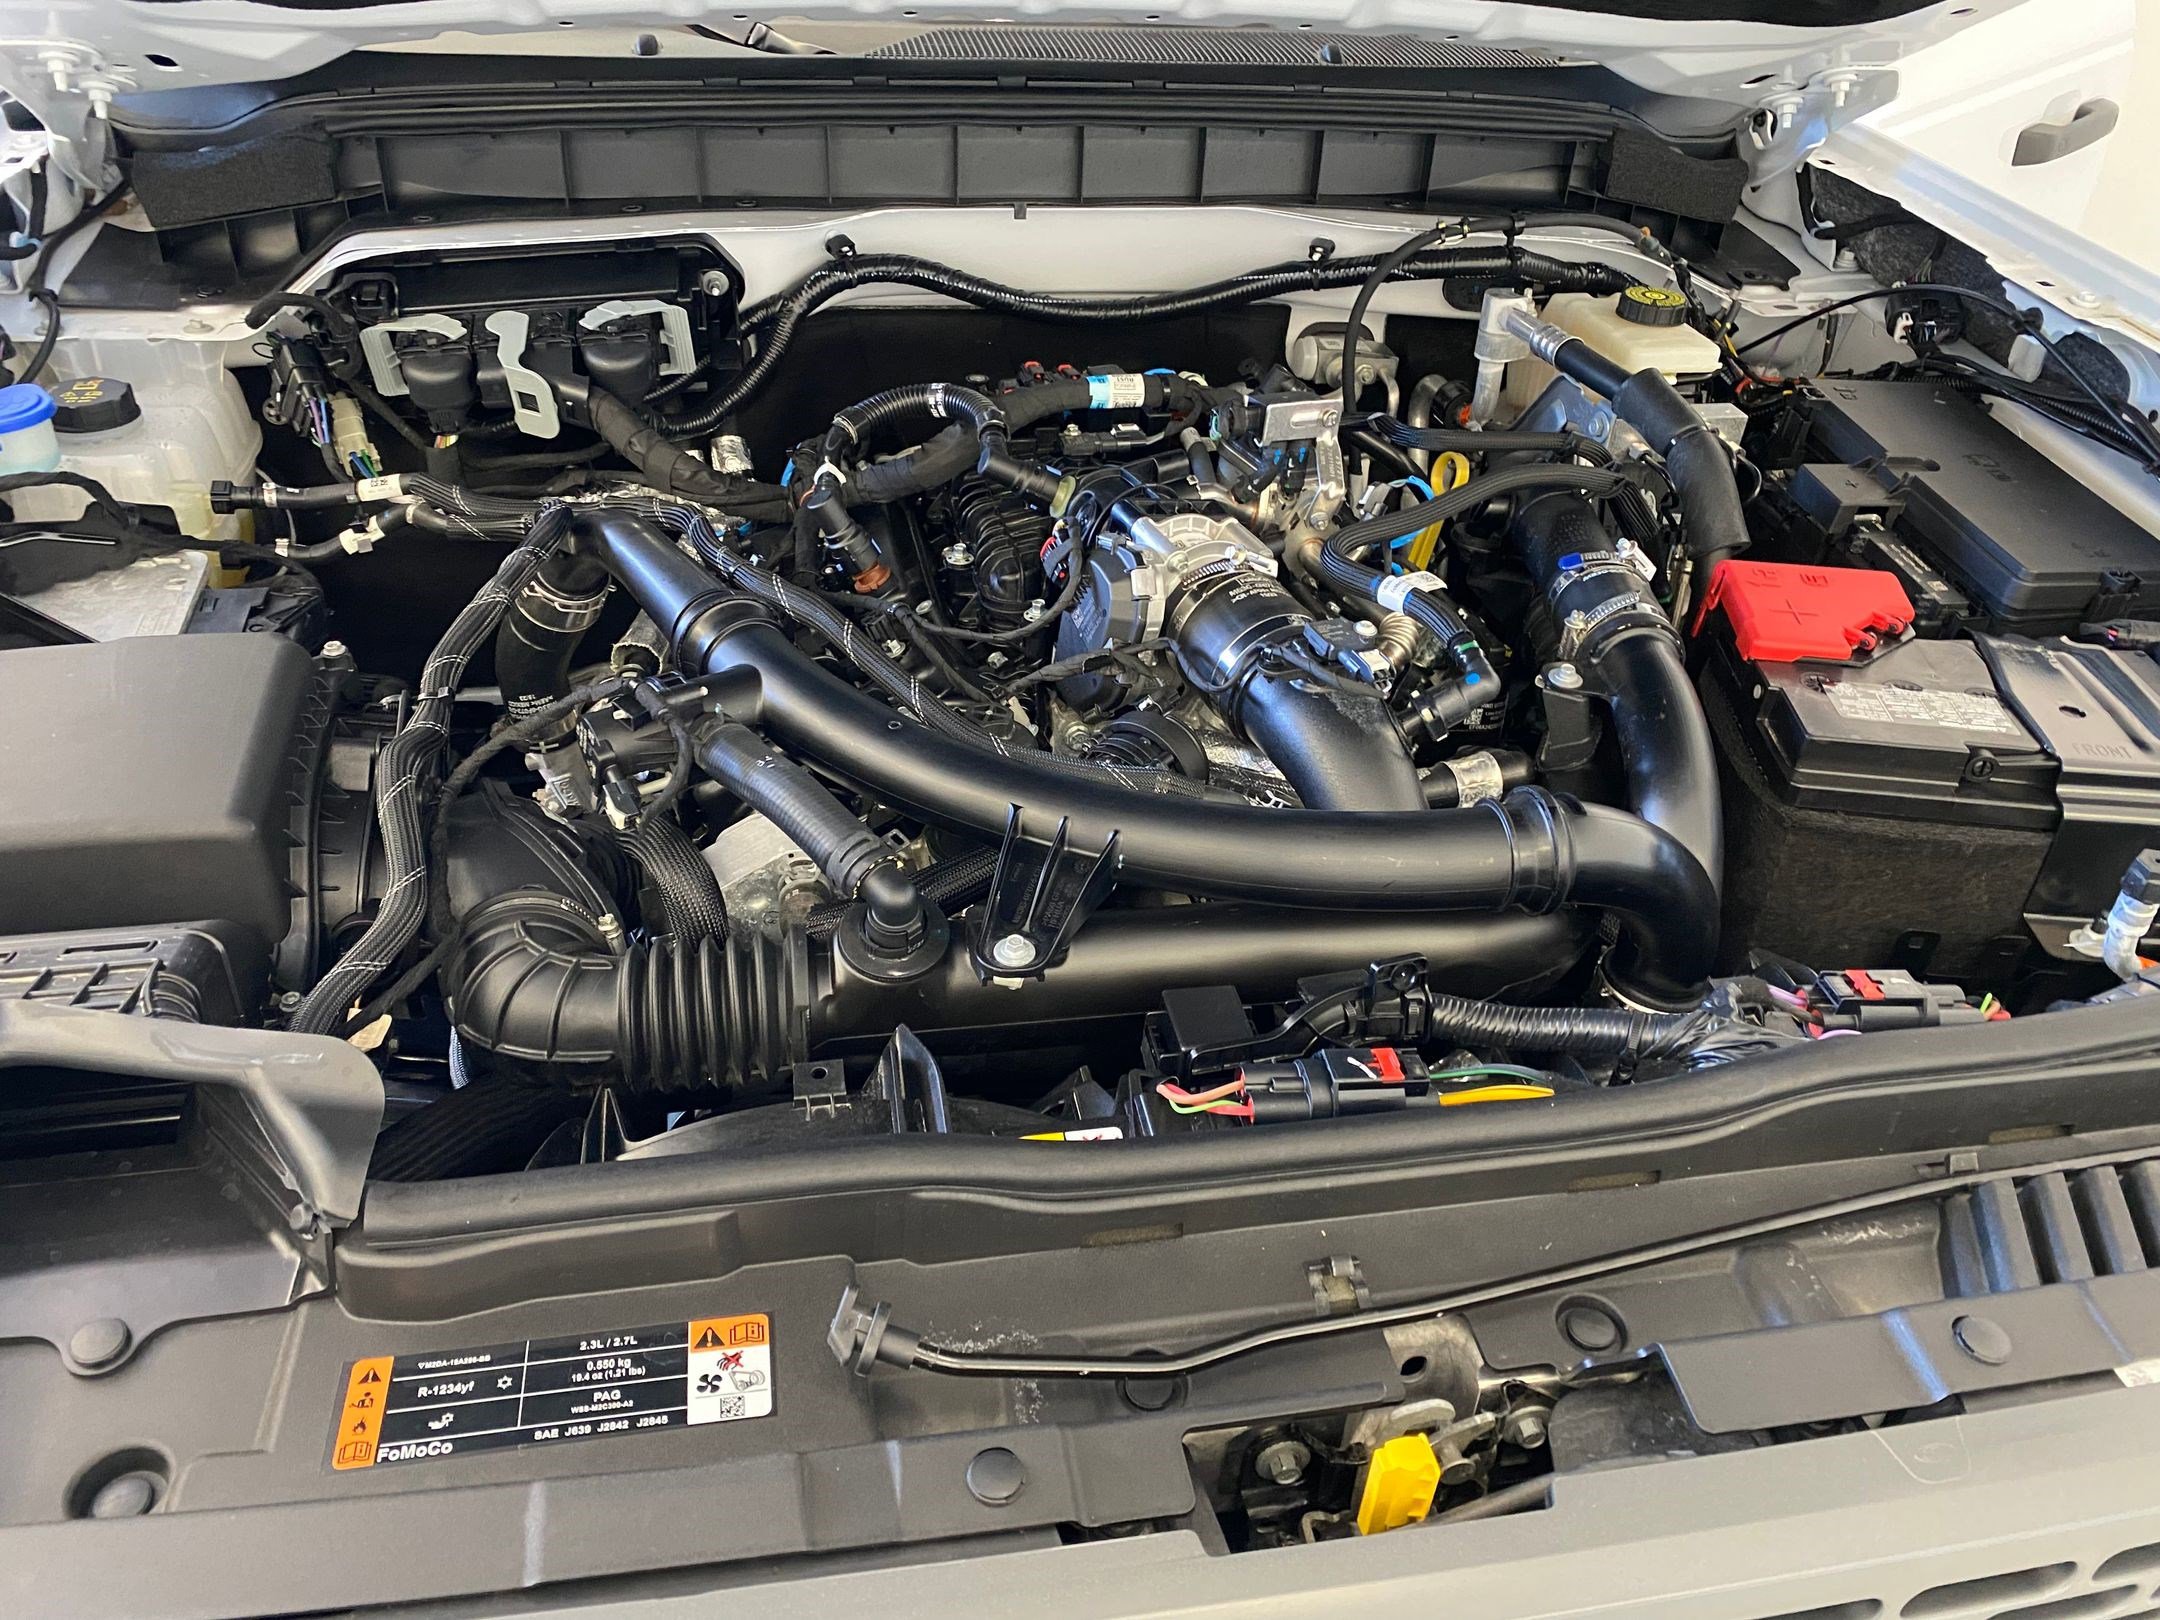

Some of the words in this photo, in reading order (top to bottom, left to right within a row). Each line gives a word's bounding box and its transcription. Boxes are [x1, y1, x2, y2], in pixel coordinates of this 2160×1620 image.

[2071, 742, 2132, 759] FRONT
[580, 1340, 604, 1351] 2.3L
[613, 1336, 638, 1347] 2.7L
[617, 1357, 632, 1369] kg
[591, 1371, 603, 1380] oz
[604, 1368, 626, 1380] (1.21
[417, 1380, 475, 1397] R-1234yf
[593, 1389, 622, 1402] PAG
[534, 1428, 559, 1440] SAE
[564, 1424, 592, 1437] J639
[597, 1420, 629, 1433] J2842
[636, 1415, 669, 1428] J2845
[376, 1441, 453, 1463] FoMoCo
